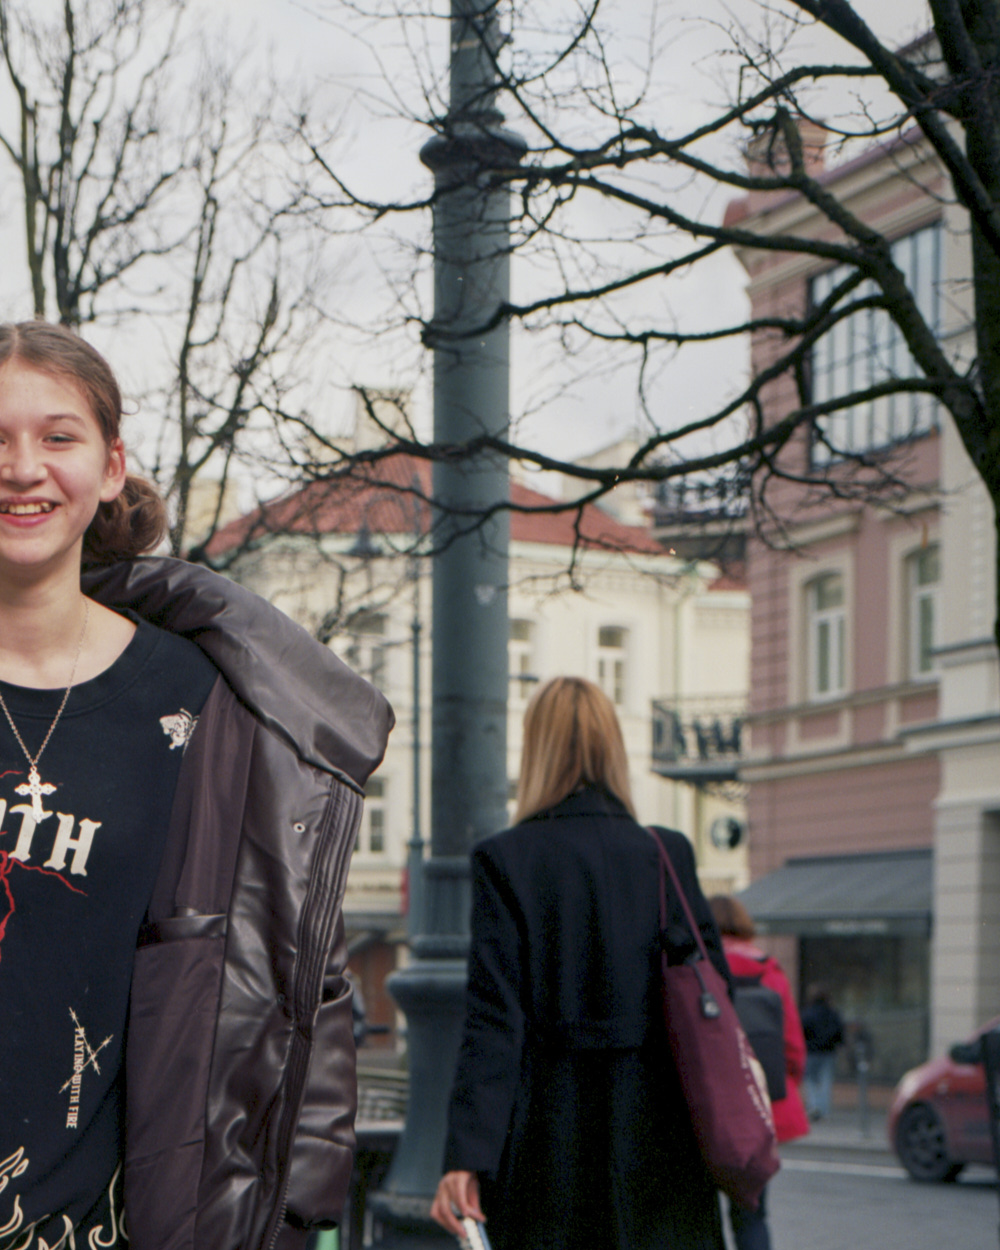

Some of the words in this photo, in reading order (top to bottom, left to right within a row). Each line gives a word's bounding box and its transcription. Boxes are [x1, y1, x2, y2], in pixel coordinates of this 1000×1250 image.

[73, 1027, 85, 1073] PLAYING
[70, 1074, 82, 1103] WITH
[66, 1105, 79, 1129] FIRE
